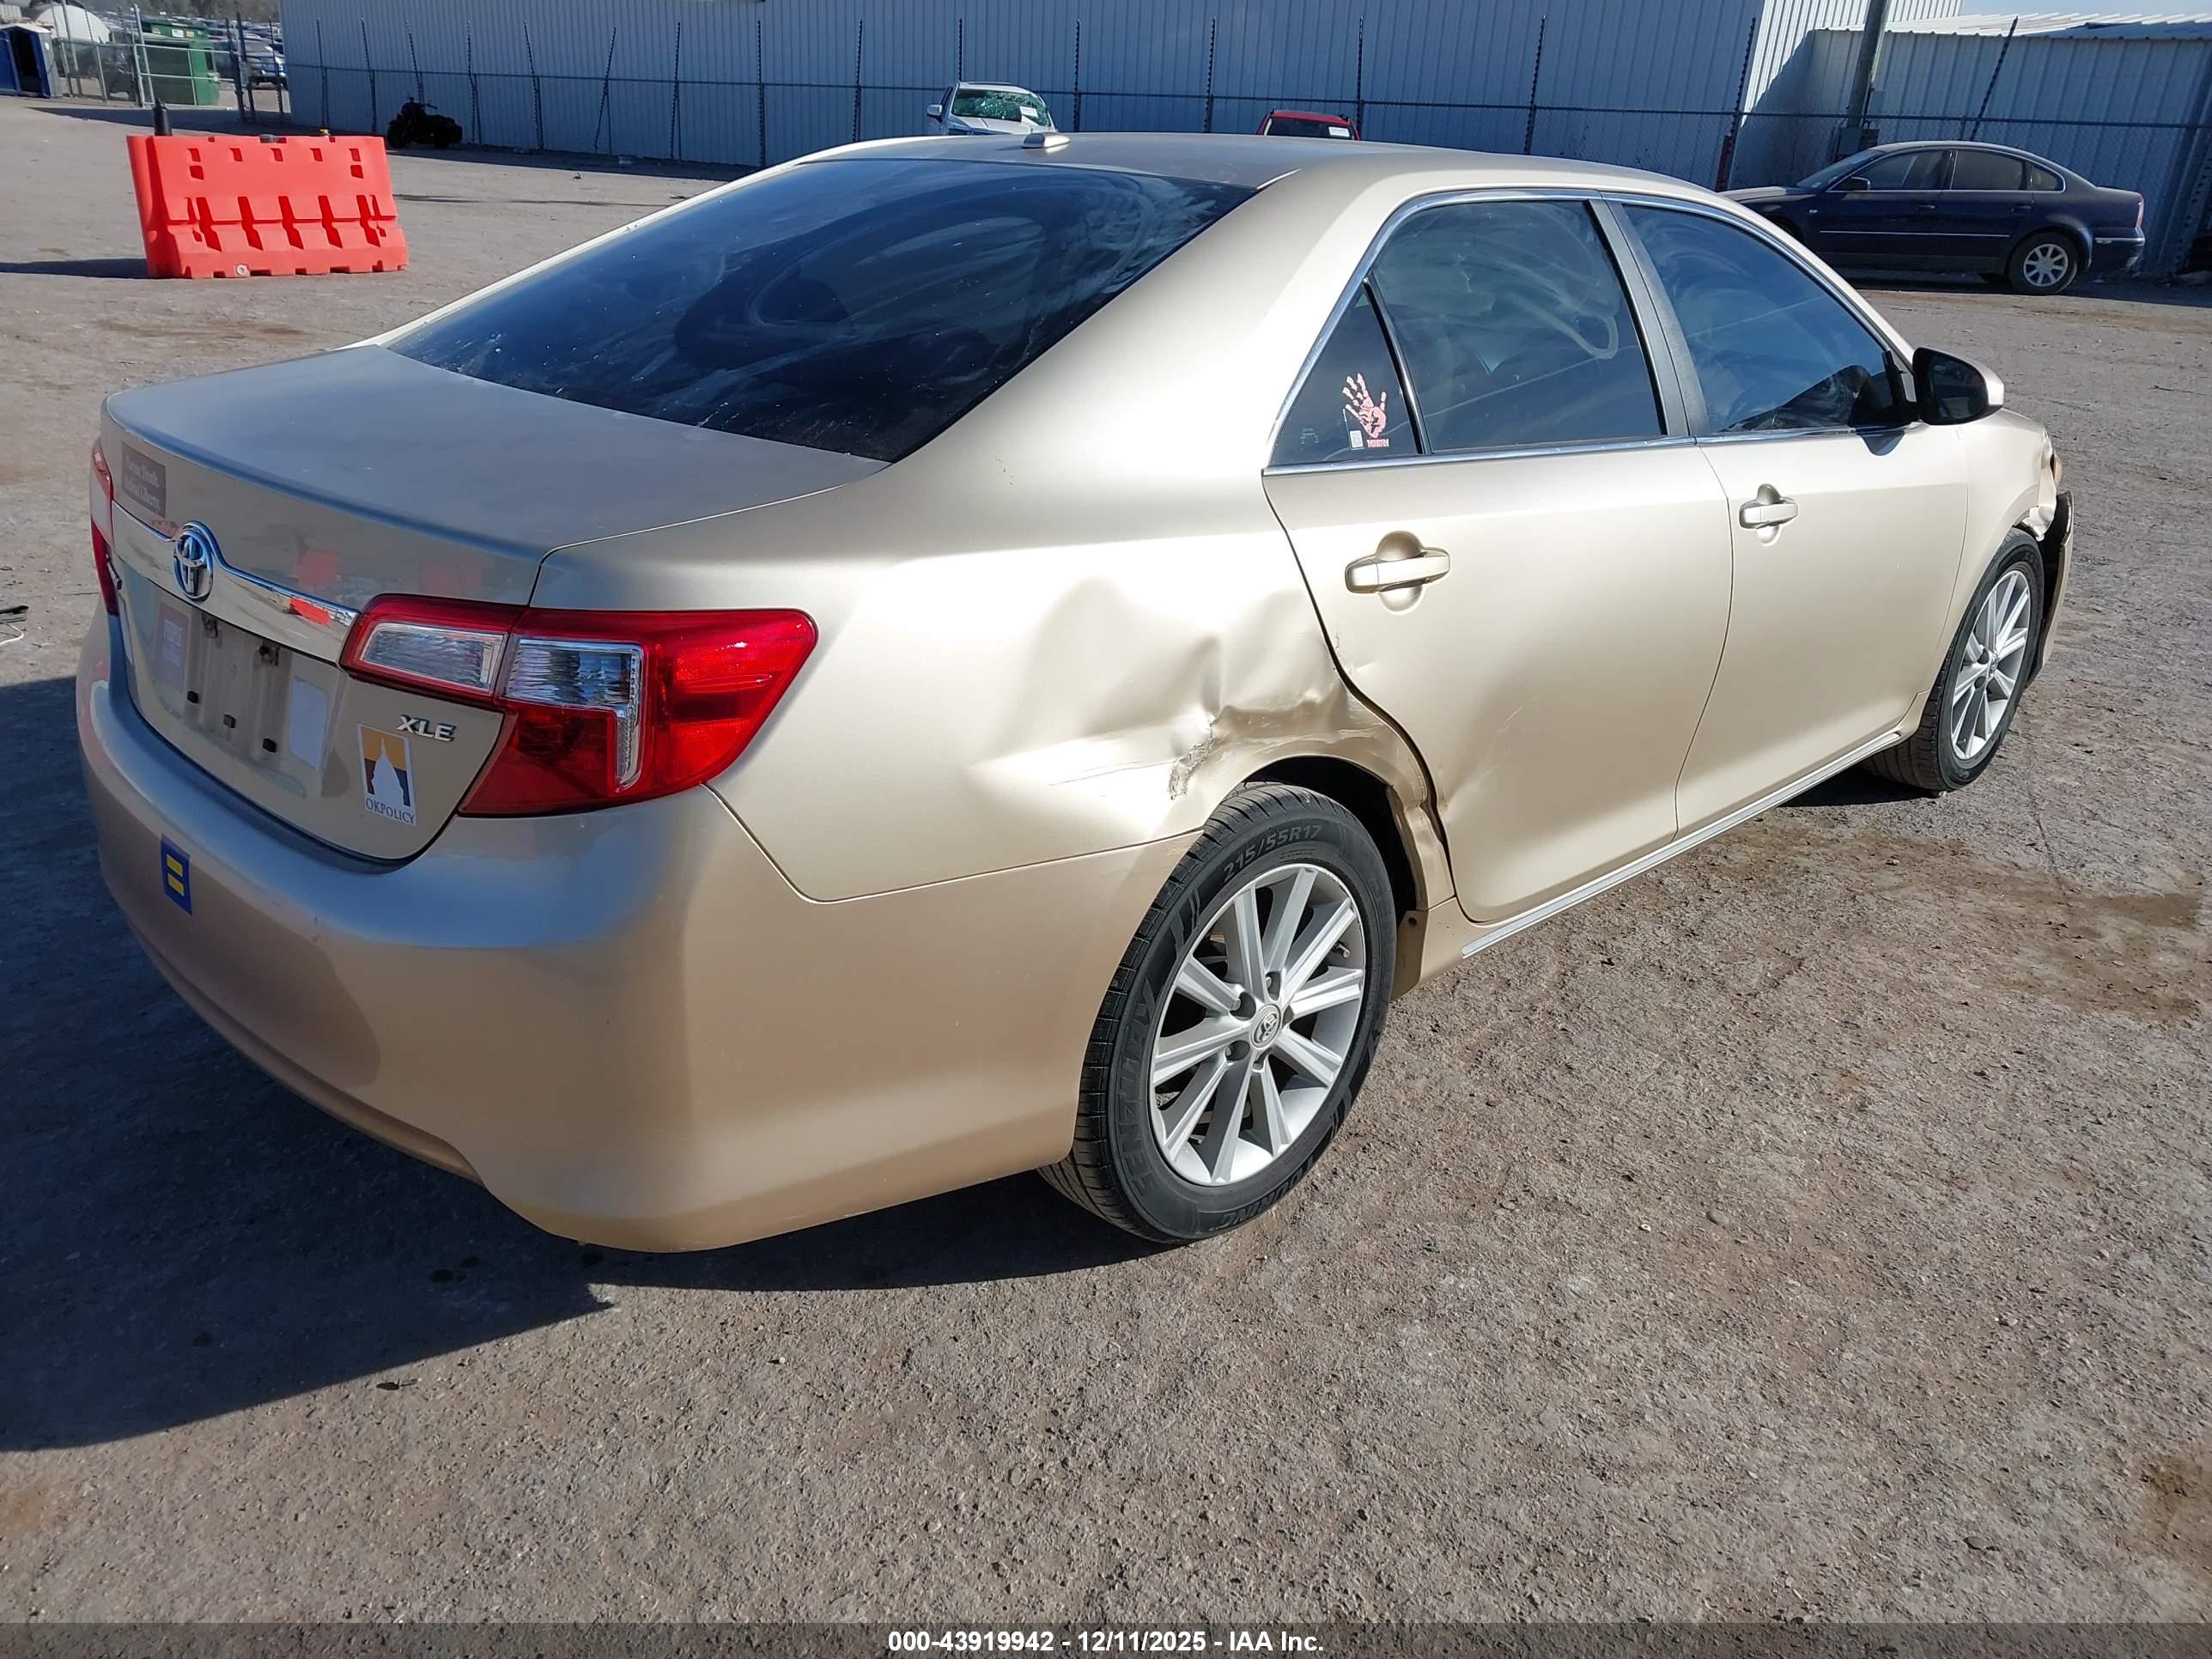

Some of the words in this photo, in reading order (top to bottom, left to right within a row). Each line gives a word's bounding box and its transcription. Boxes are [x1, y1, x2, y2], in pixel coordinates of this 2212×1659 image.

[396, 714, 457, 743] XLE
[366, 797, 415, 824] OKPOLICY
[1222, 823, 1322, 884] 215/55R17
